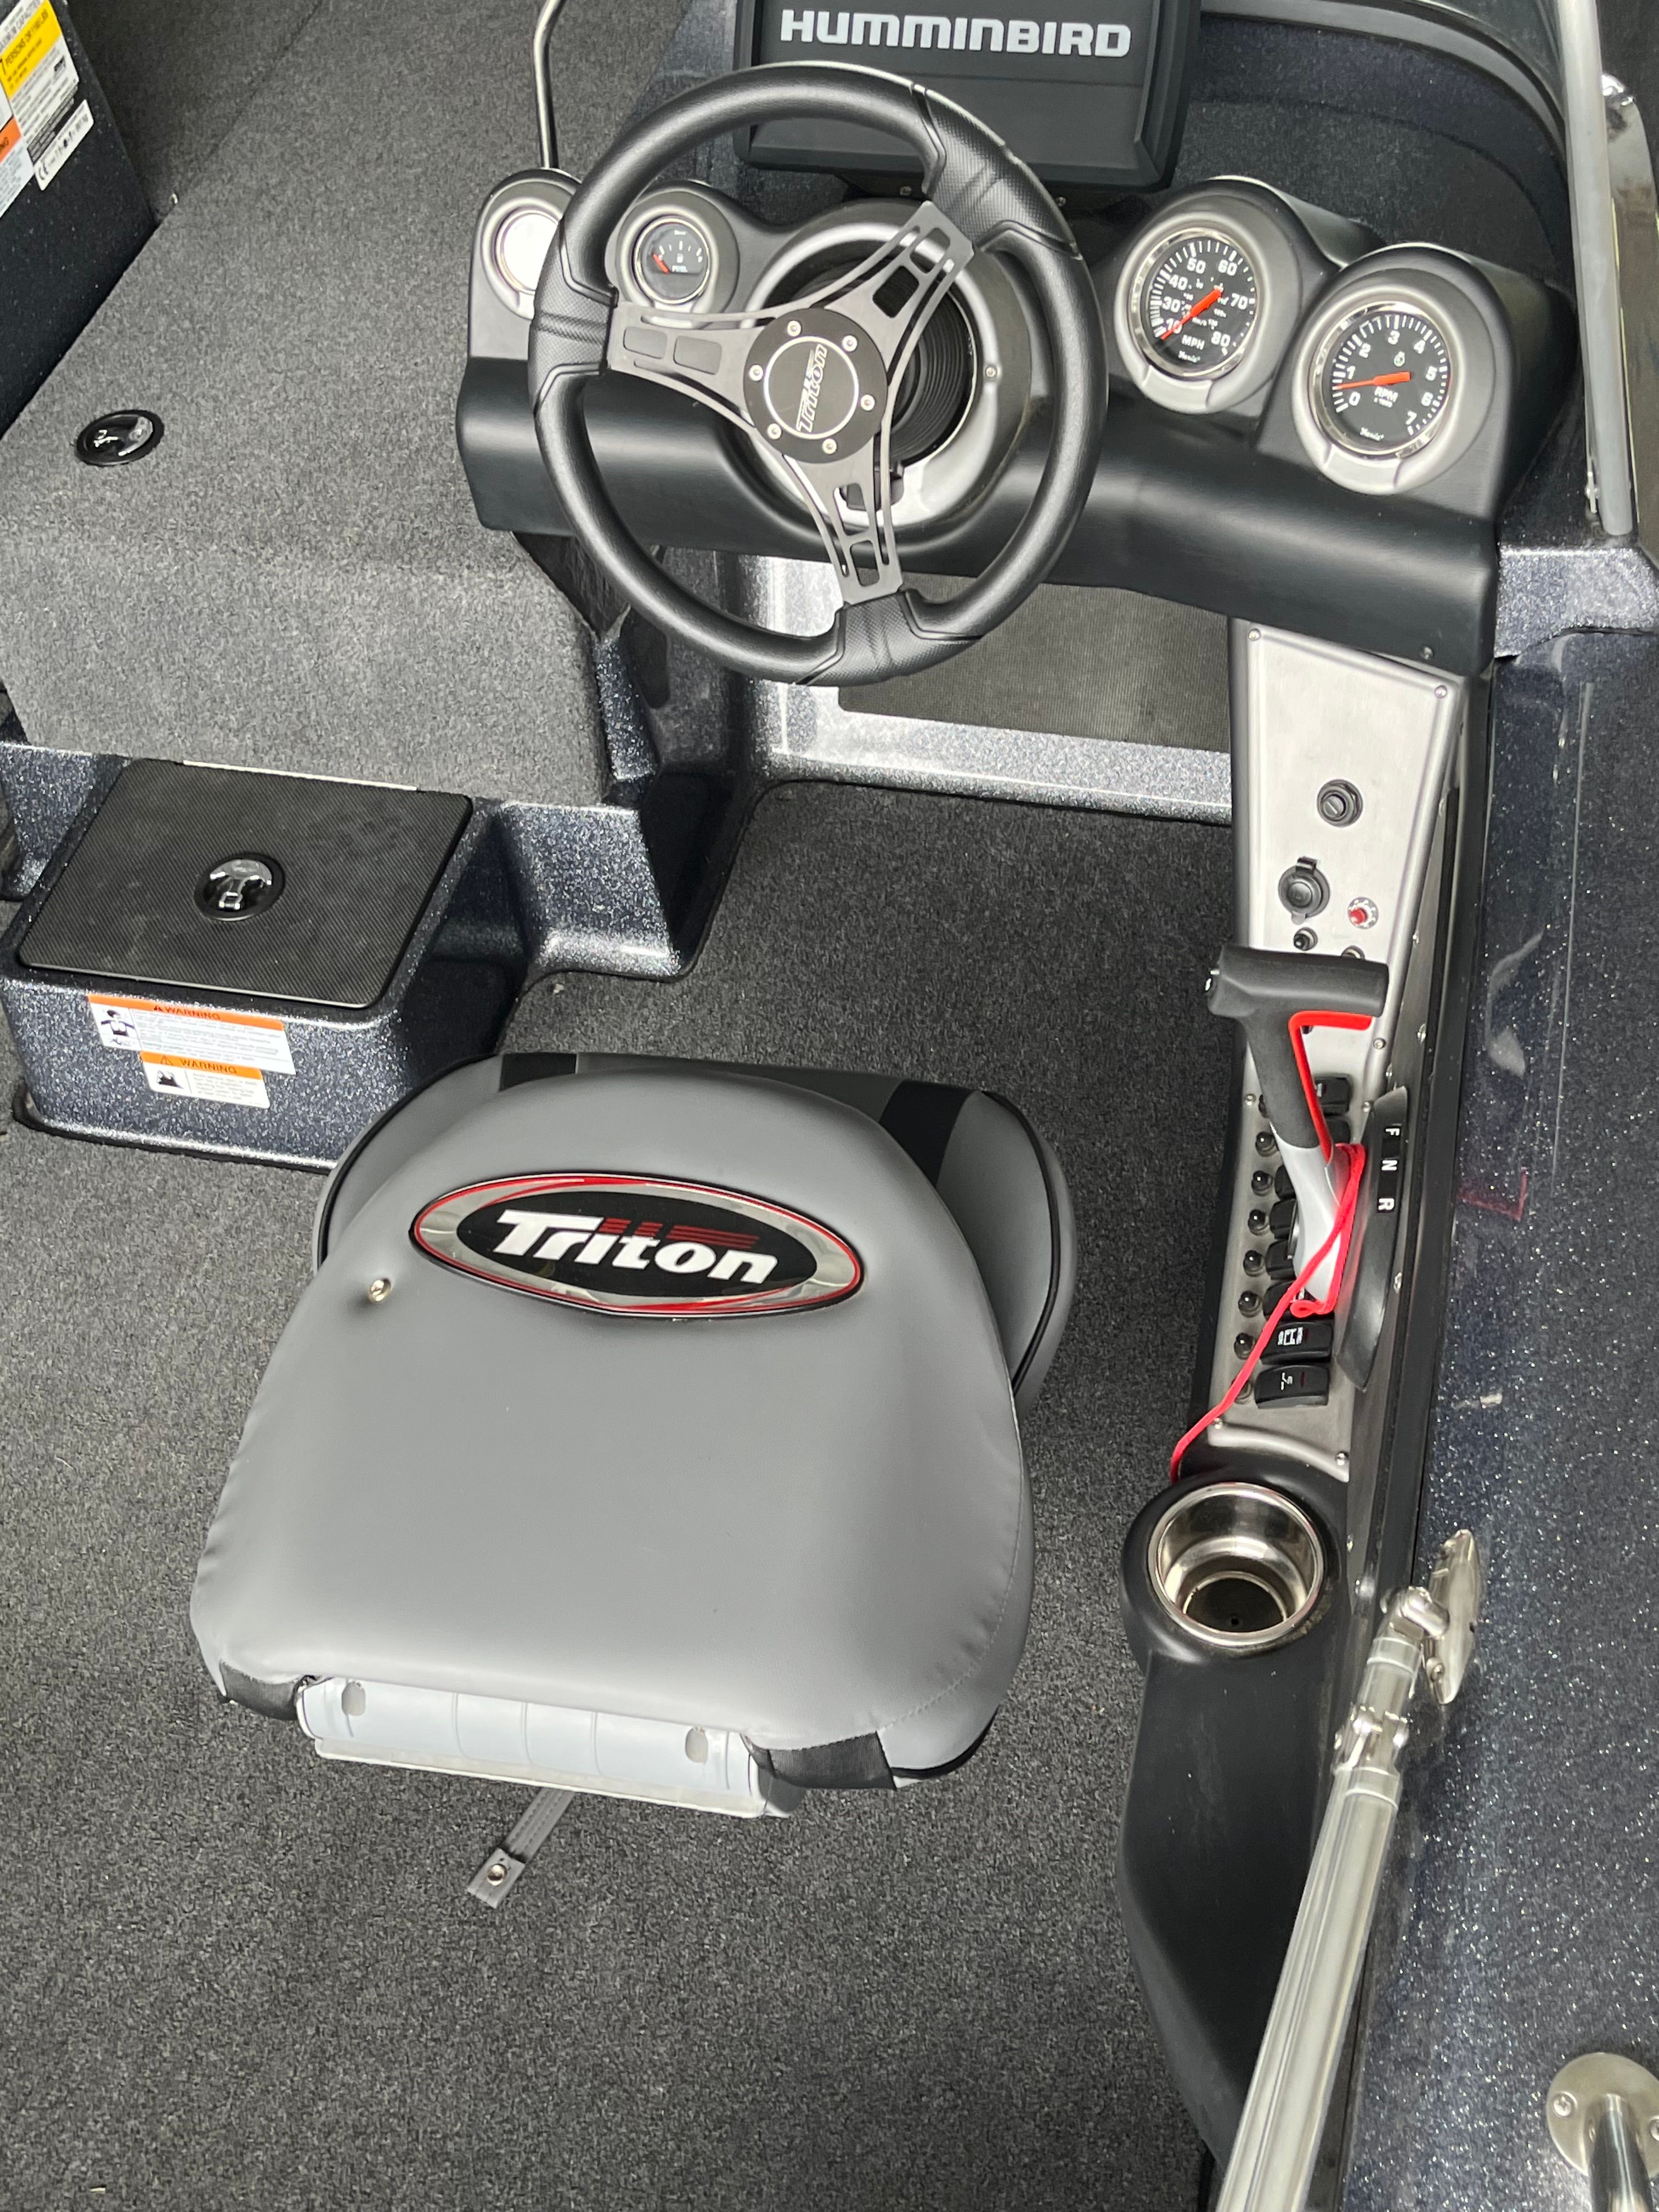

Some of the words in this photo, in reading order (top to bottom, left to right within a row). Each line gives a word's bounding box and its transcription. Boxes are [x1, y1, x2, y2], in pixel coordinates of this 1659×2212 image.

[780, 9, 1132, 58] HUMMINBIRD
[1187, 257, 1206, 274] 50
[1218, 259, 1238, 276] 60
[1169, 274, 1188, 291] 40
[1162, 296, 1181, 313] 30
[1231, 292, 1248, 311] 70
[1166, 318, 1183, 334] 10
[1181, 334, 1205, 350] MPH
[1211, 330, 1231, 348] 80
[1388, 330, 1401, 345] 3
[1359, 343, 1372, 359] 2
[1413, 339, 1426, 354] 4
[1346, 365, 1356, 380] 1
[1425, 365, 1438, 381] 5
[795, 344, 828, 433] Triton
[1374, 386, 1398, 403] RPM
[1348, 391, 1361, 406] 0
[1421, 391, 1434, 407] 6
[1405, 410, 1418, 425] 7
[164, 1006, 221, 1020] WARNING
[178, 1058, 238, 1074] WARNING
[1385, 1127, 1401, 1136] F
[1381, 1159, 1398, 1171] N
[1378, 1197, 1395, 1211] R
[493, 1209, 778, 1284] Triton
